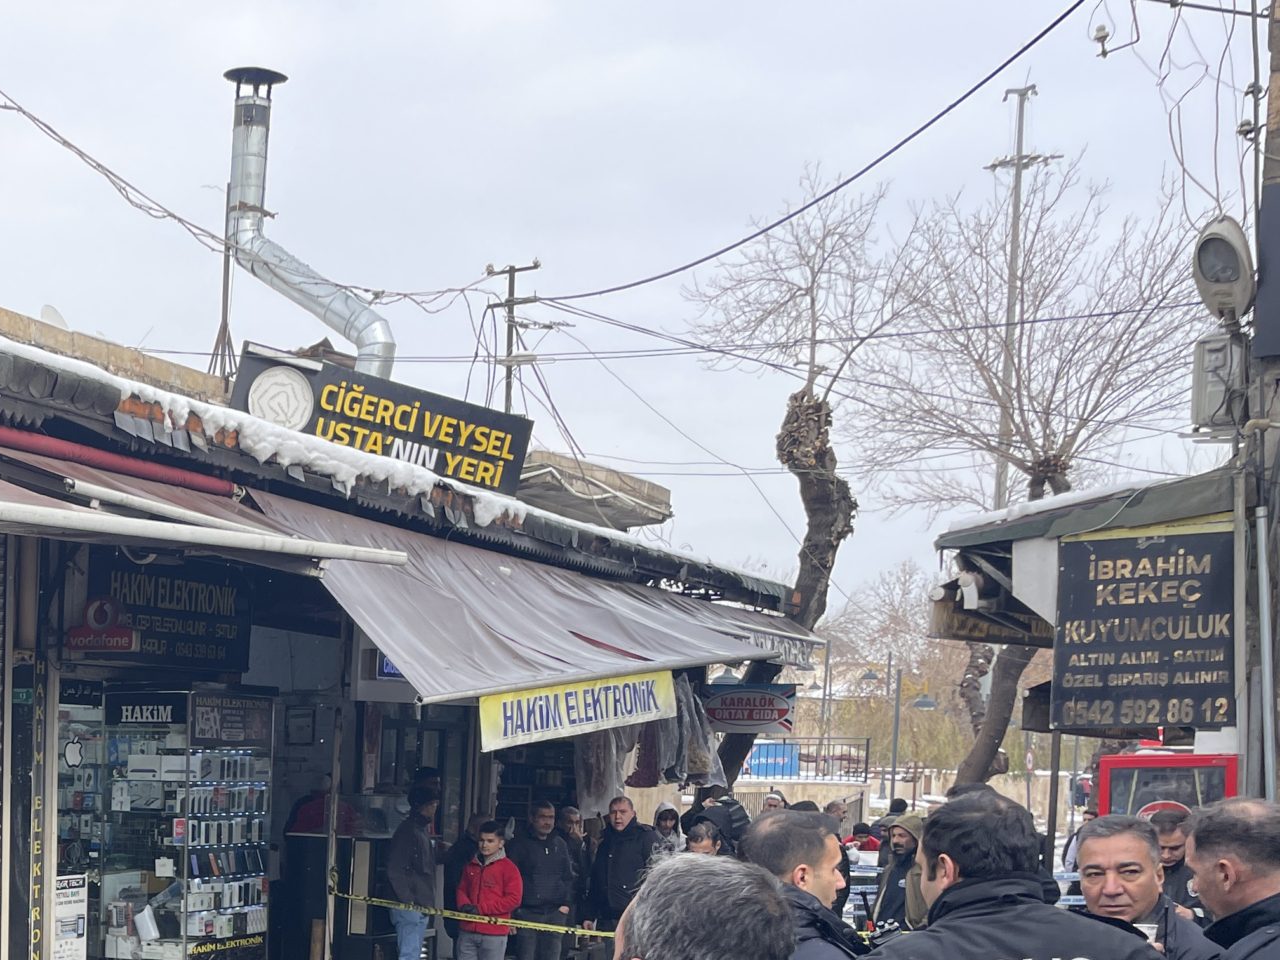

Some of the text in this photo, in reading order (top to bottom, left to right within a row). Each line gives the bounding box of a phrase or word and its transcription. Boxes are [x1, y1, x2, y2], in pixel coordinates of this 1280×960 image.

[320, 381, 515, 460] CİĞERCİ VEYSEL
[445, 451, 504, 488] YERİ
[1089, 549, 1211, 580] İBRAHİM
[1096, 579, 1201, 608] KEKEÇ
[70, 634, 129, 647] vodafone
[1065, 613, 1230, 643] KUYUMCULUK
[1069, 652, 1115, 666] ALTIN
[1119, 651, 1159, 664] ALIM
[1173, 648, 1224, 663] SATIM
[1062, 672, 1103, 687] ÖZEL
[1173, 671, 1228, 684] ALINIR
[715, 710, 778, 720] OKTAY GIDA
[1062, 697, 1228, 725] 0542 592 86 12
